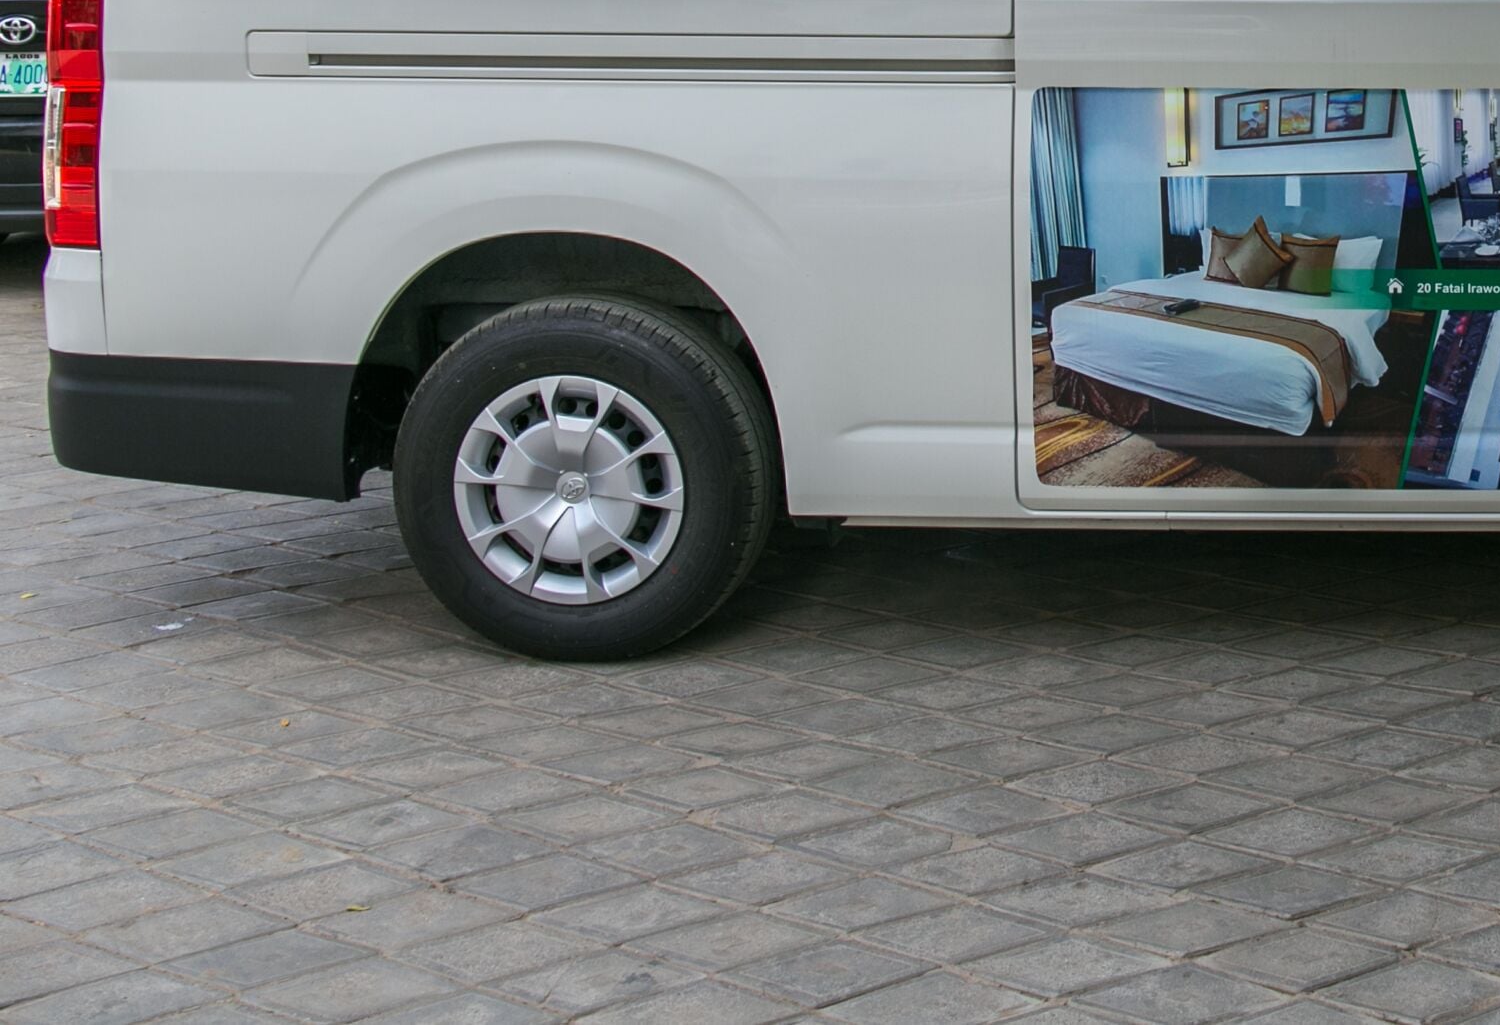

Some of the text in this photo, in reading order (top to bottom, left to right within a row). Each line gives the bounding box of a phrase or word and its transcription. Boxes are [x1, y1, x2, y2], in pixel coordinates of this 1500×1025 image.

[1417, 282, 1432, 294] 20
[1434, 282, 1464, 294] Fatai
[1467, 283, 1500, 294] Irawo
